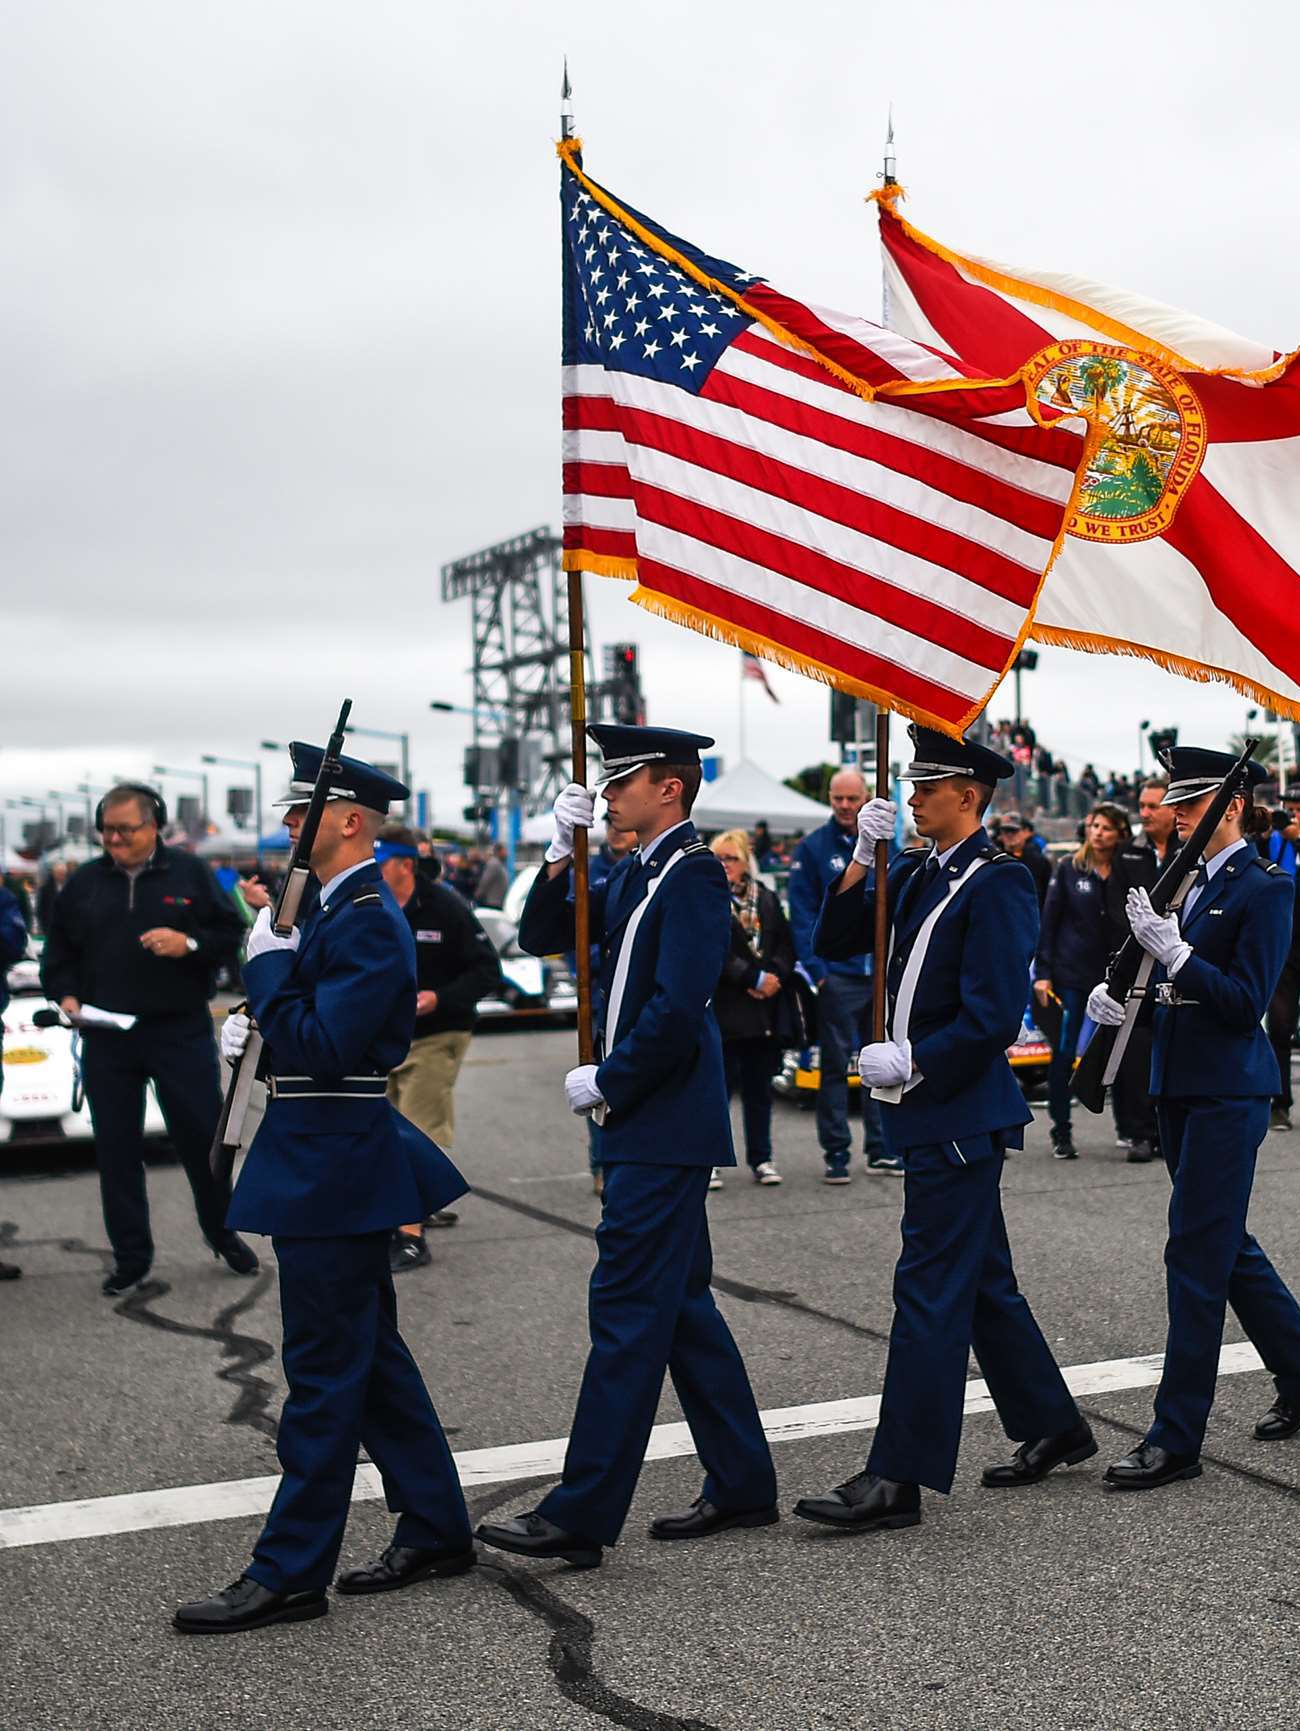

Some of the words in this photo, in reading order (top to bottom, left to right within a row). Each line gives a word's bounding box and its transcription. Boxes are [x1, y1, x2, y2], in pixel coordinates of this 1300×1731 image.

[1059, 343, 1082, 357] OF
[1092, 343, 1127, 356] THE
[1027, 352, 1056, 383] EAL
[1135, 352, 1179, 391] STATE
[1179, 394, 1198, 419] OF
[1168, 420, 1201, 496] FLORIDA
[1085, 520, 1111, 537] WE
[1117, 512, 1166, 537] TRUST
